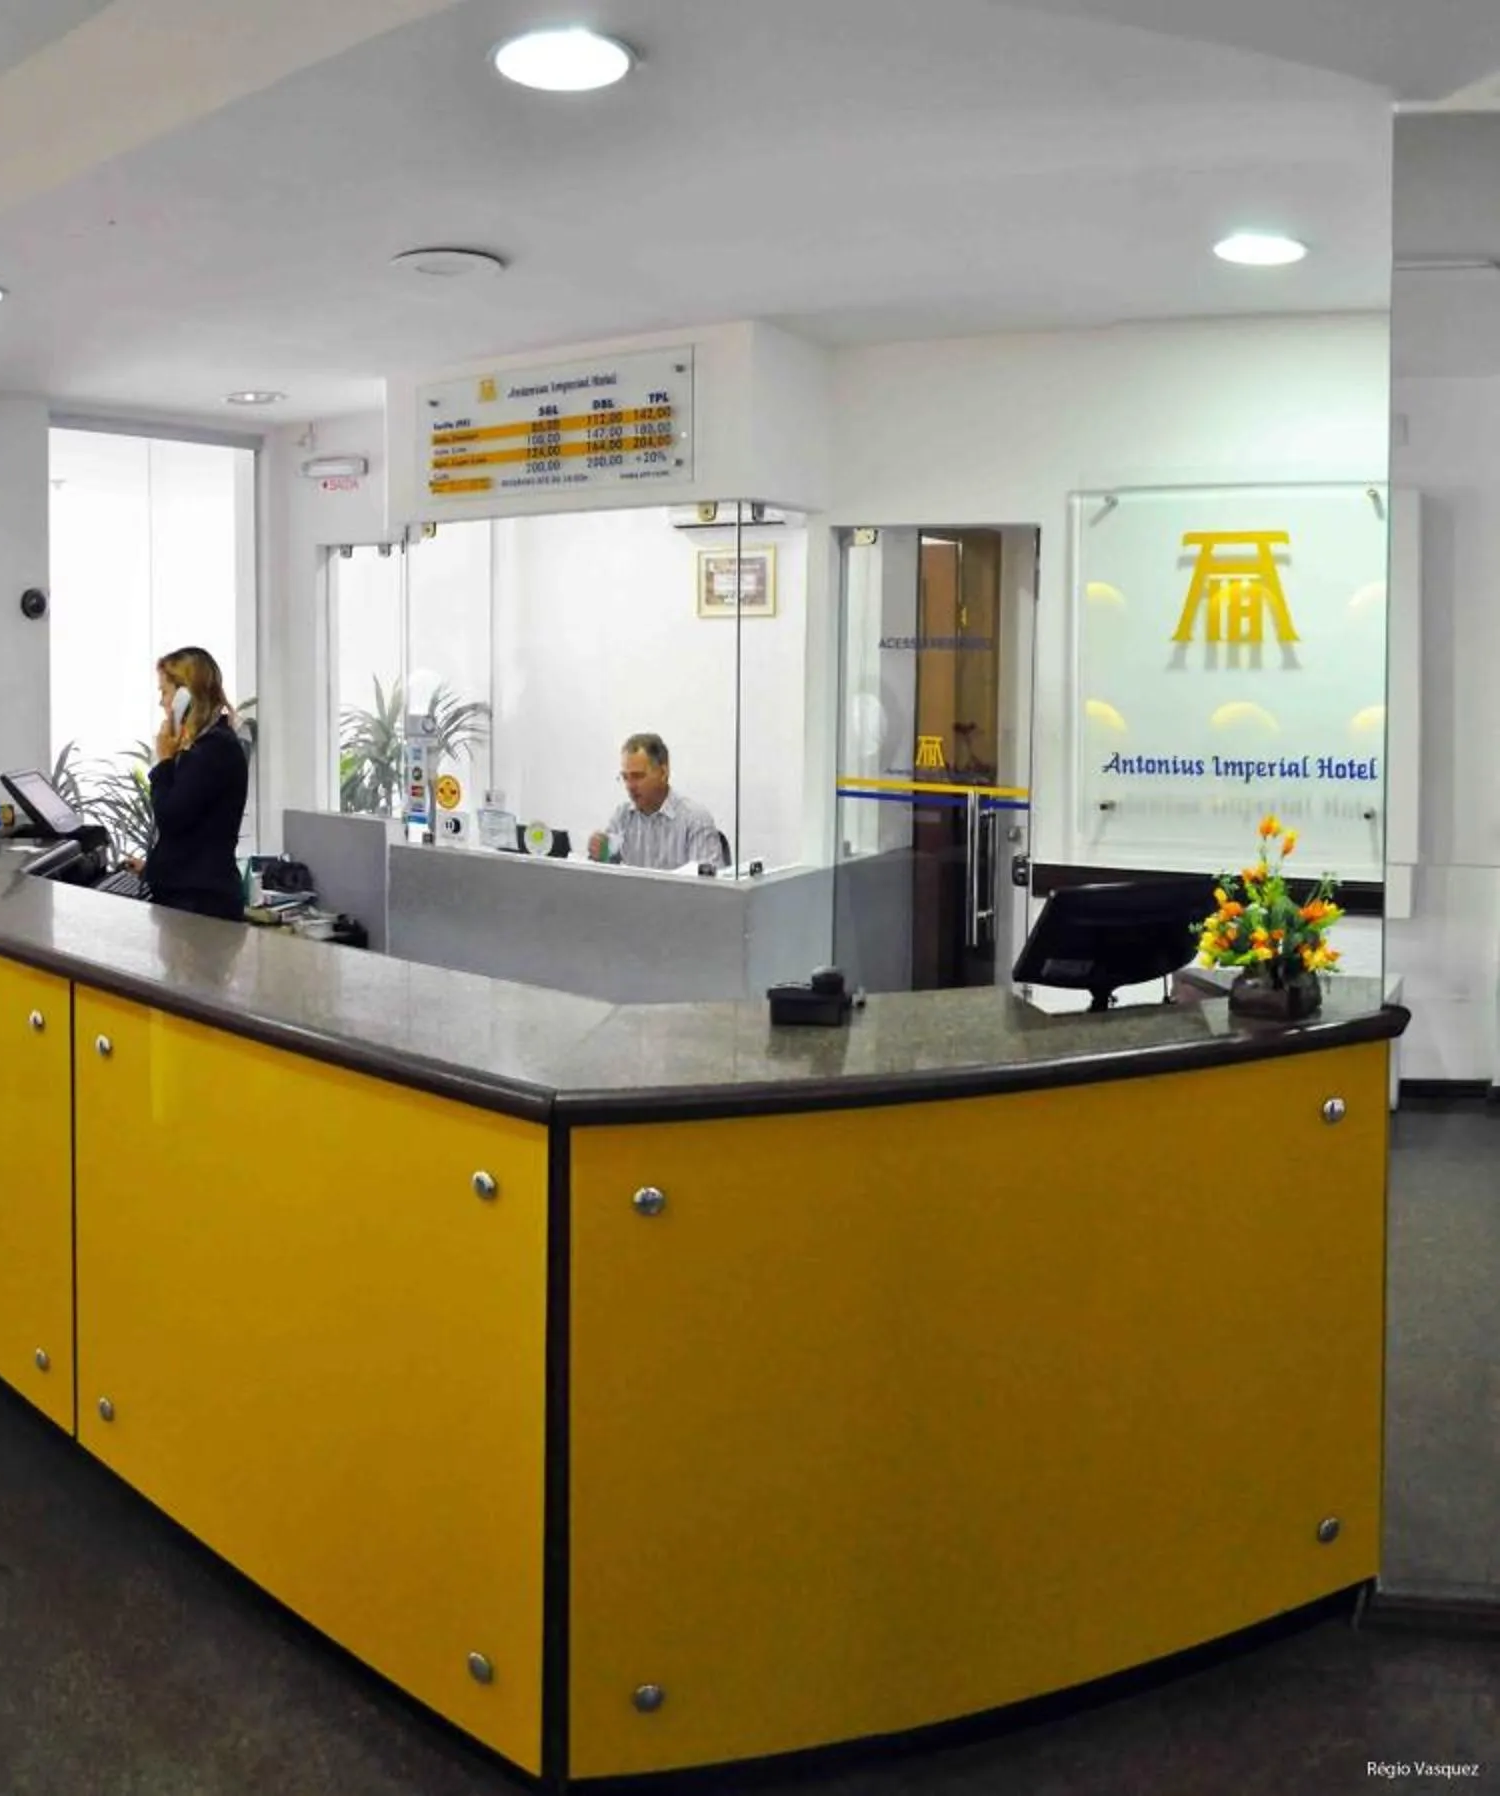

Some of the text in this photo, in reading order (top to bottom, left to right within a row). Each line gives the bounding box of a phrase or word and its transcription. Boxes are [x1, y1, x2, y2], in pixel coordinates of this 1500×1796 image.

[648, 391, 669, 403] TPL
[1102, 752, 1378, 784] Antonius Imperial Hotel
